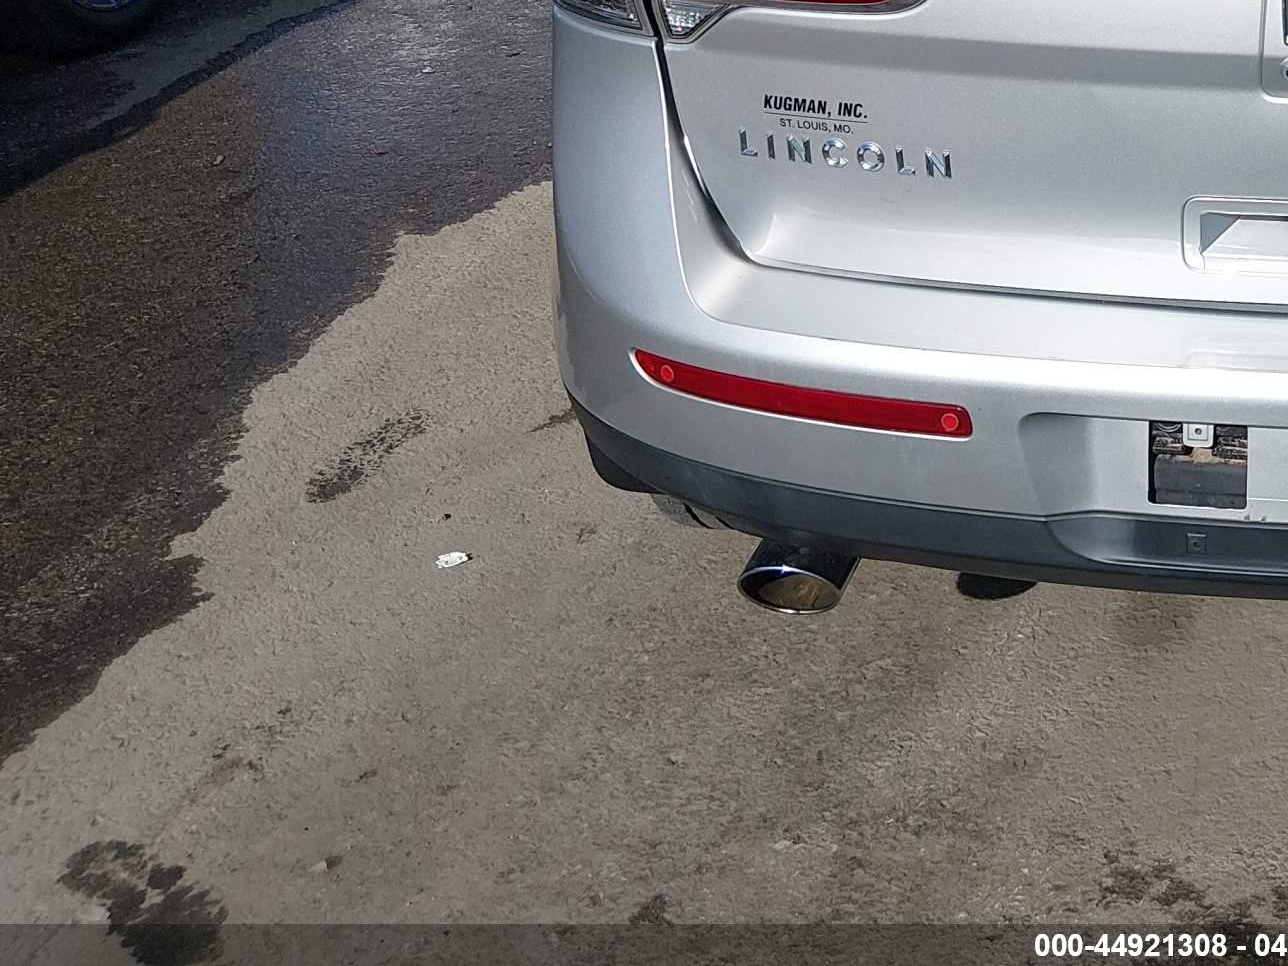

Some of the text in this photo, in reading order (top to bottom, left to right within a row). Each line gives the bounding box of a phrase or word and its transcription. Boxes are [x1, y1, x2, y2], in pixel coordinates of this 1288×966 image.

[763, 94, 868, 119] KUGMAN, INC.
[779, 118, 854, 134] ST. LOUIS, MO.
[739, 128, 952, 178] LINCOLN
